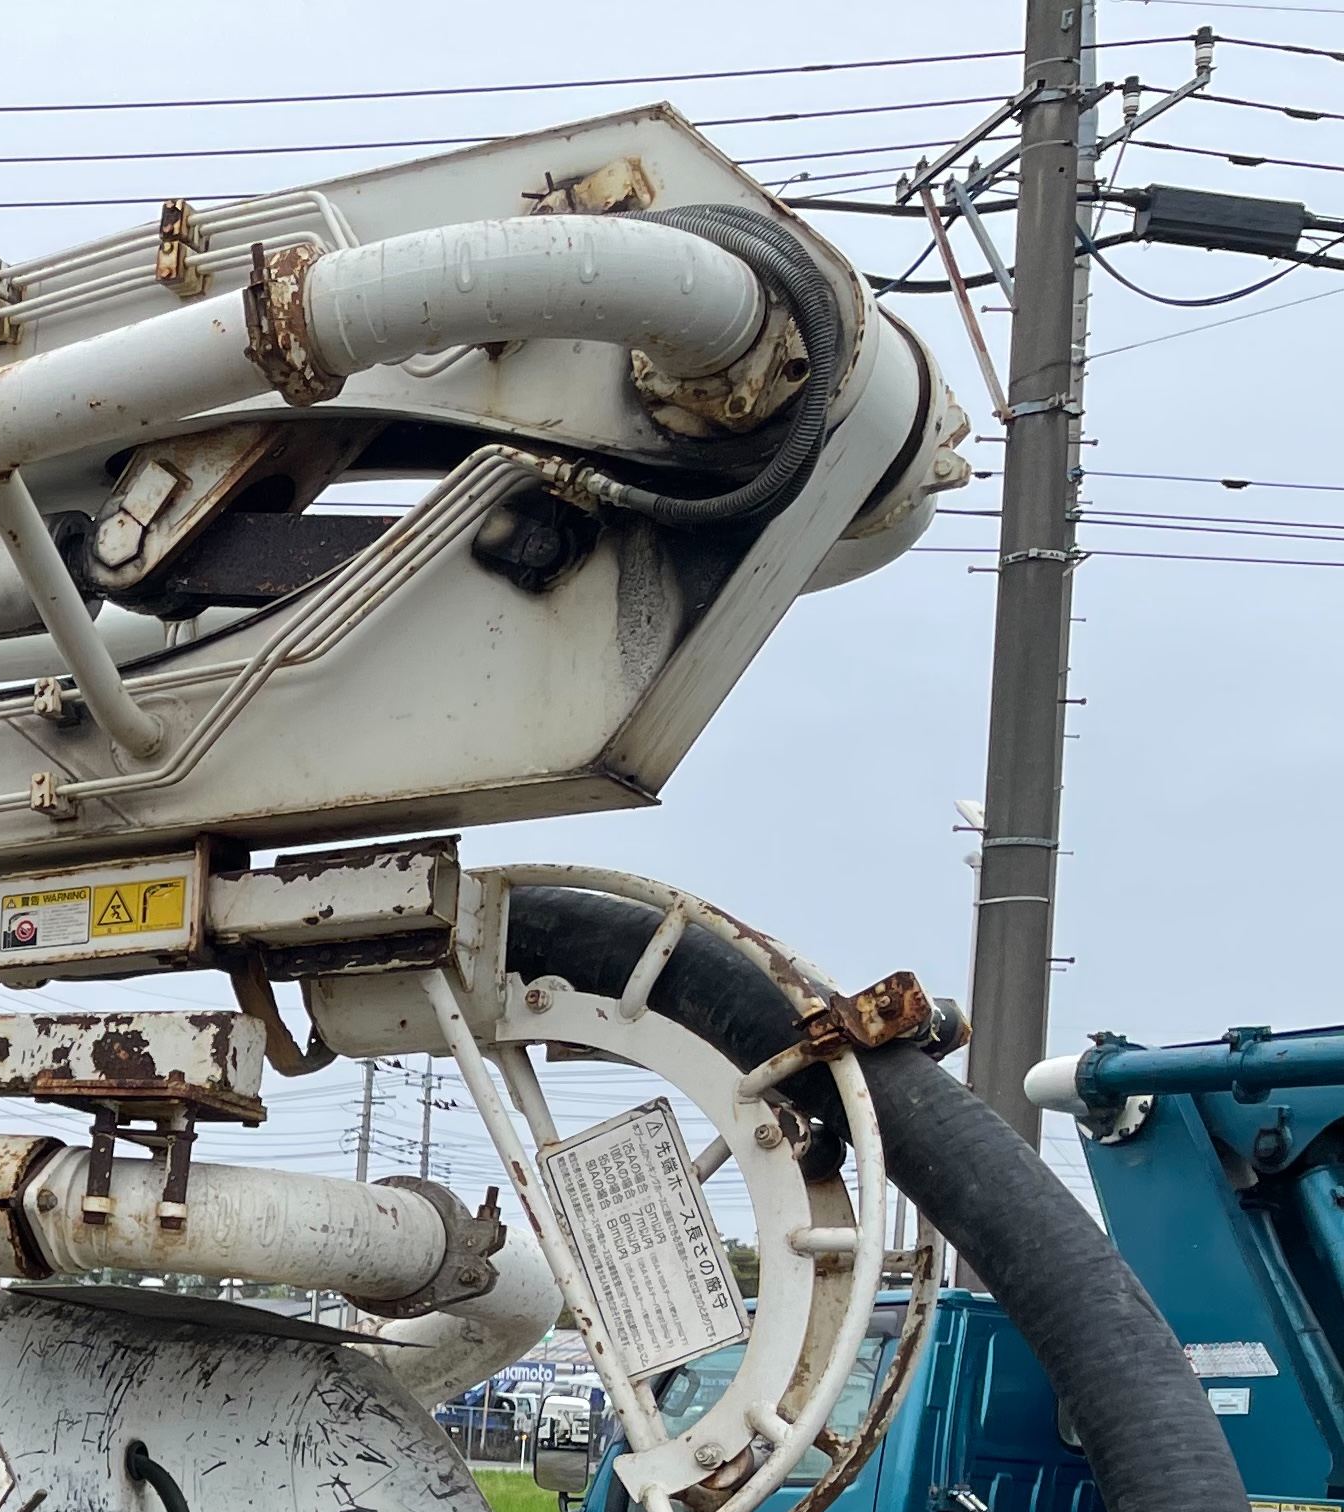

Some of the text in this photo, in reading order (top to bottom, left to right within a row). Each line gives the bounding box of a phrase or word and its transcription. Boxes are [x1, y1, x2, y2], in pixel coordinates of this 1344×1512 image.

[43, 889, 86, 903] WARNING
[653, 1139, 730, 1313] 先端ホース長さの厳守
[496, 1363, 553, 1382] namoto
